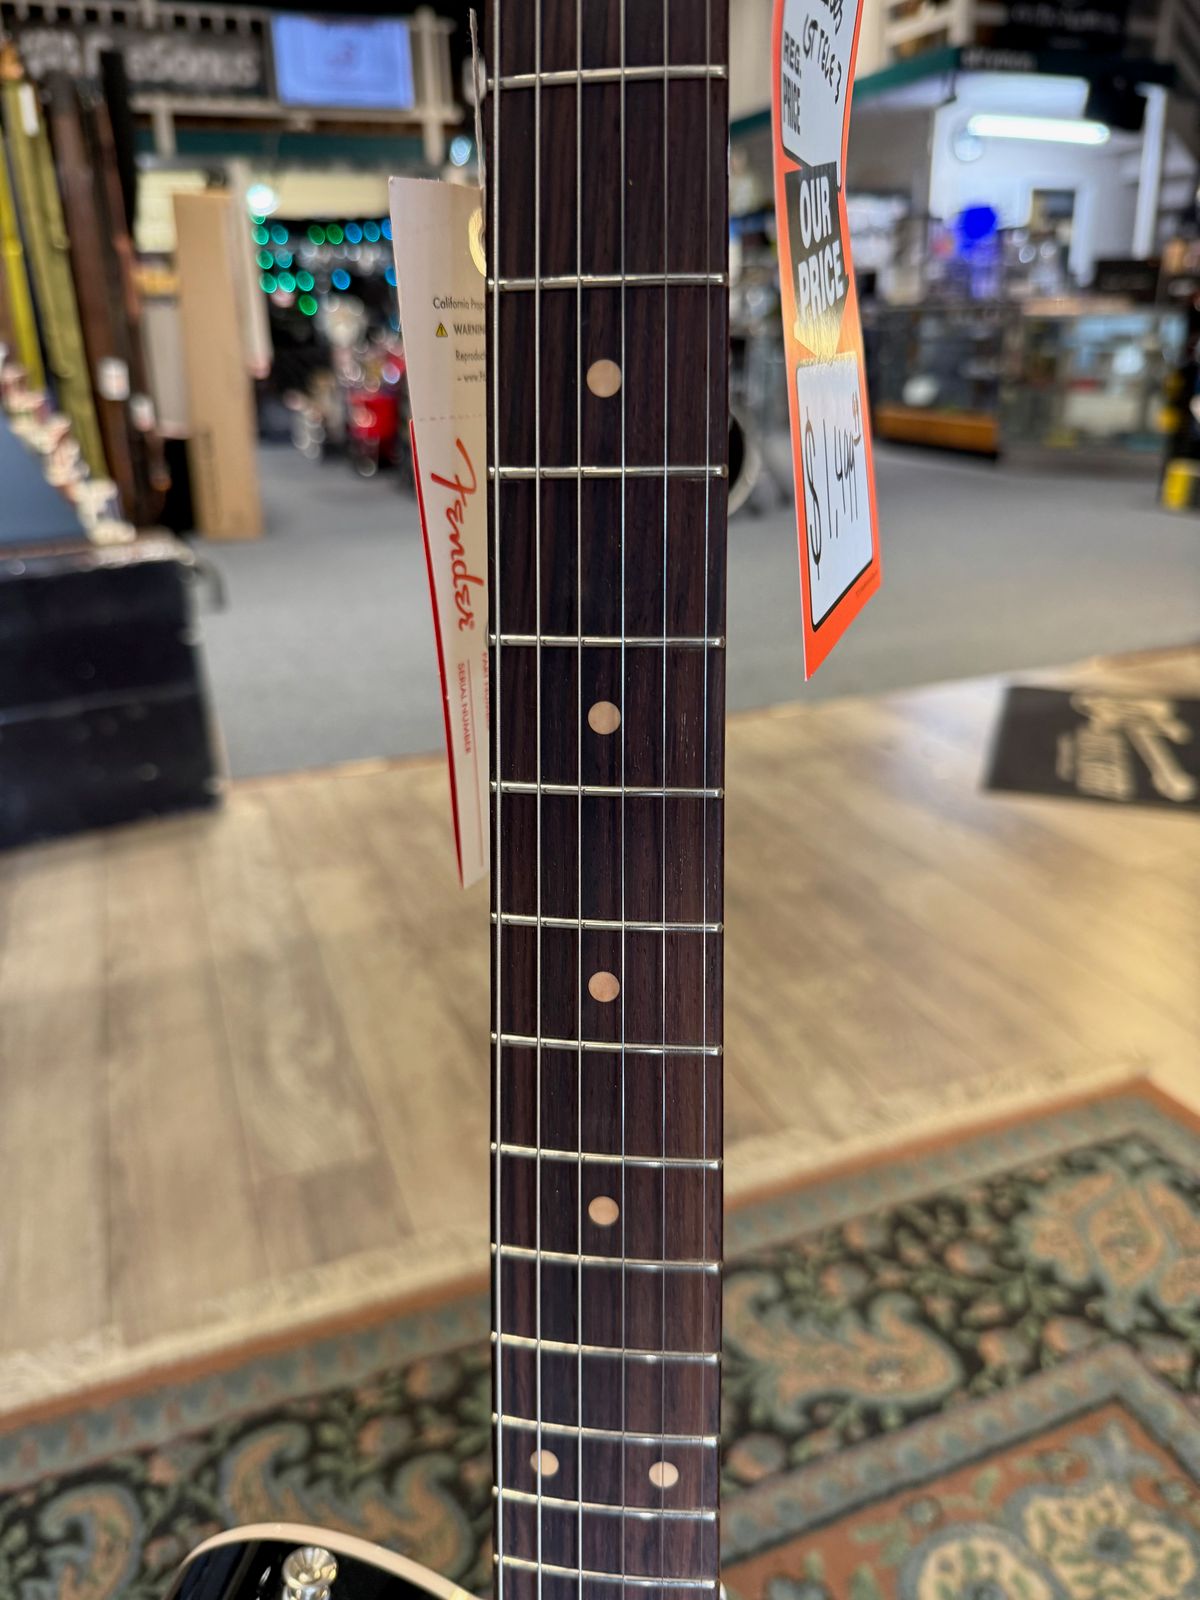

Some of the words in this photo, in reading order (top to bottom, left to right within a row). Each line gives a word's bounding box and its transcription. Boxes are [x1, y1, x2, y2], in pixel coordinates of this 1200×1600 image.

[783, 31, 801, 77] REG.
[783, 74, 801, 135] PRICE
[800, 175, 831, 249] OUR
[433, 297, 469, 311] California
[798, 240, 844, 323] PRICE
[453, 323, 486, 336] WARNIN
[455, 350, 486, 364] Reproduc
[431, 437, 485, 632] Fender
[458, 662, 467, 701] SERIAL
[462, 702, 471, 754] NUMBER
